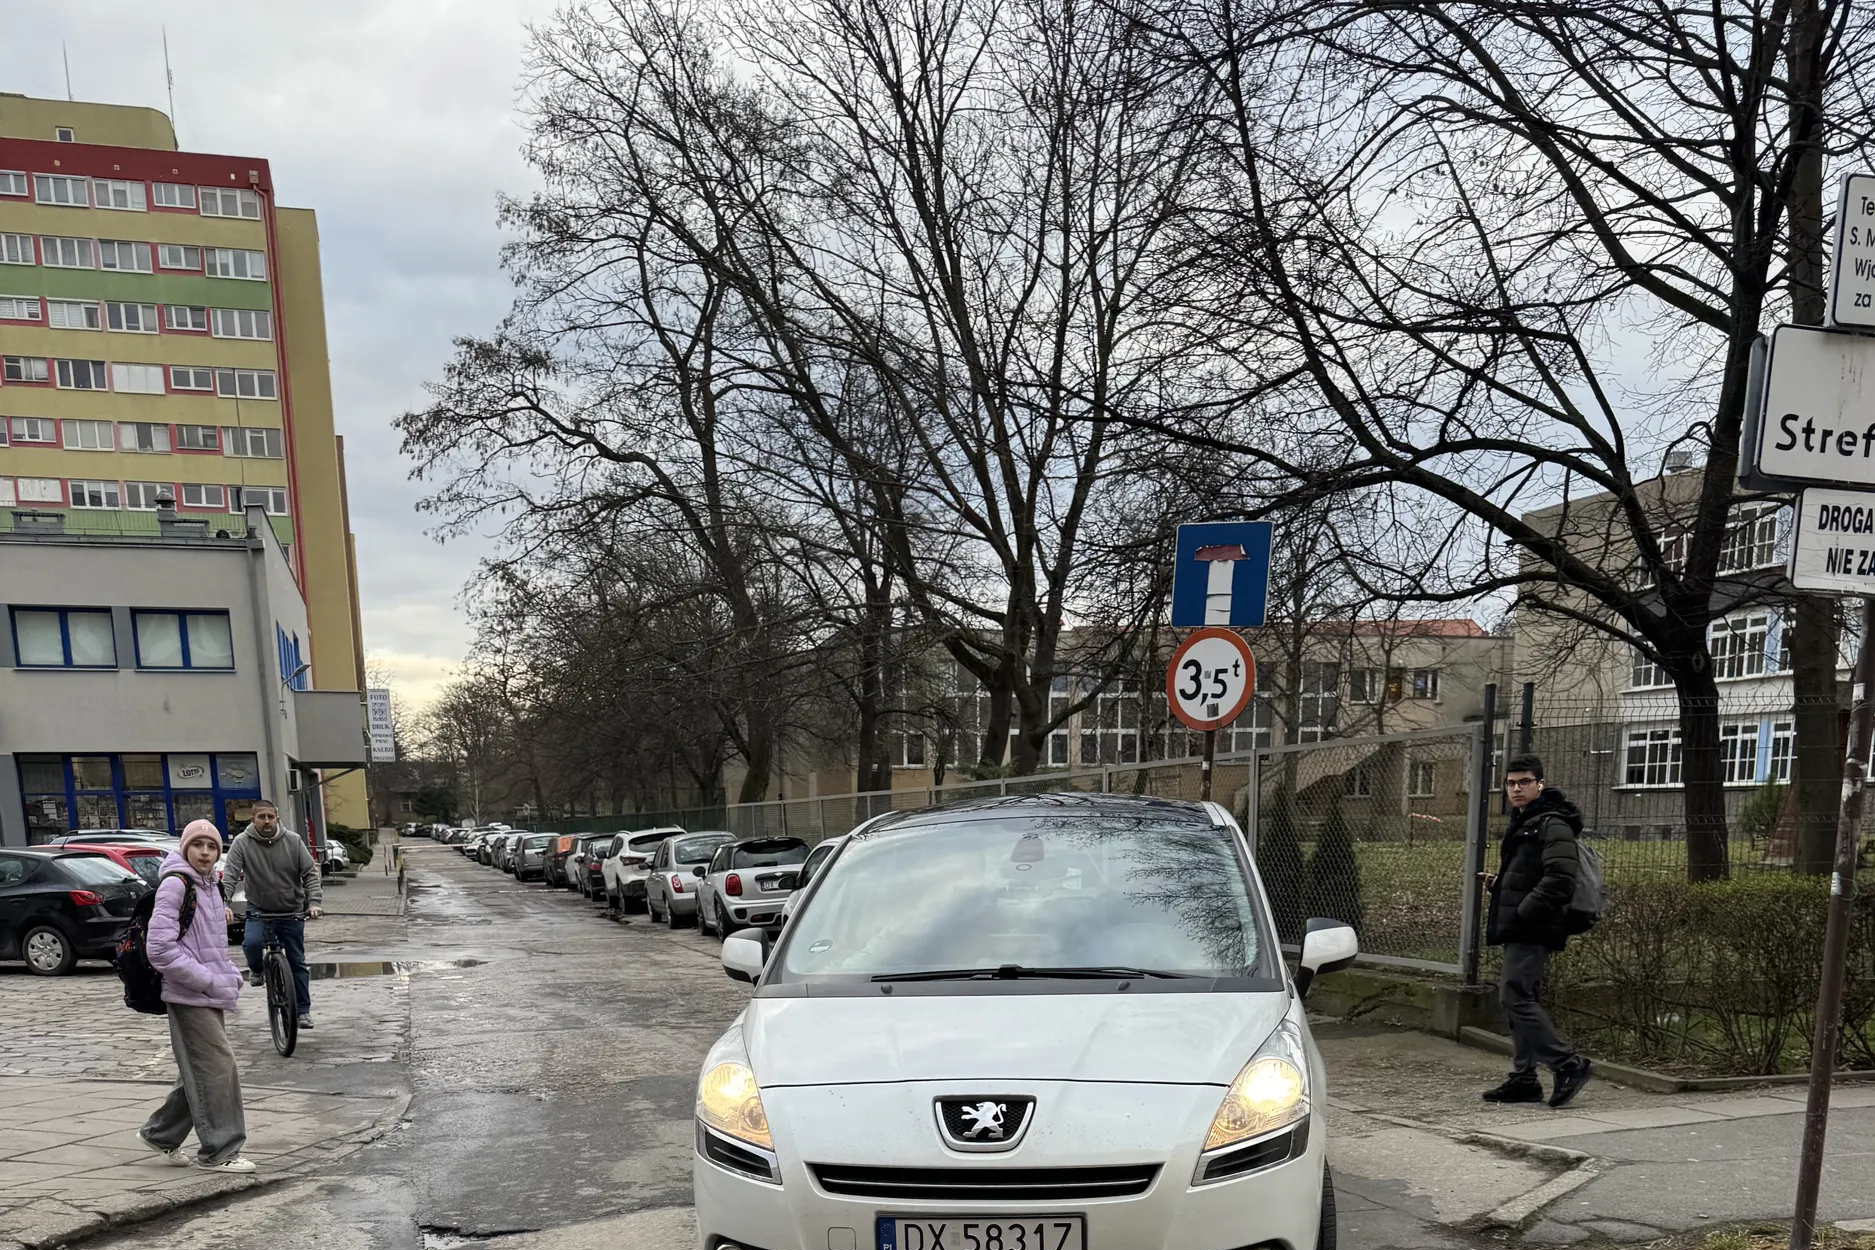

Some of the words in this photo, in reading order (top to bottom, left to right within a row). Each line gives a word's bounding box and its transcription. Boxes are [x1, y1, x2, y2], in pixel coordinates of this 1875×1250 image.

[1850, 226, 1861, 246] S.
[1854, 292, 1872, 308] za
[1775, 413, 1875, 458] Stref
[1818, 504, 1874, 535] DROGA
[1826, 547, 1854, 576] NIE
[182, 768, 200, 777] LOTTO
